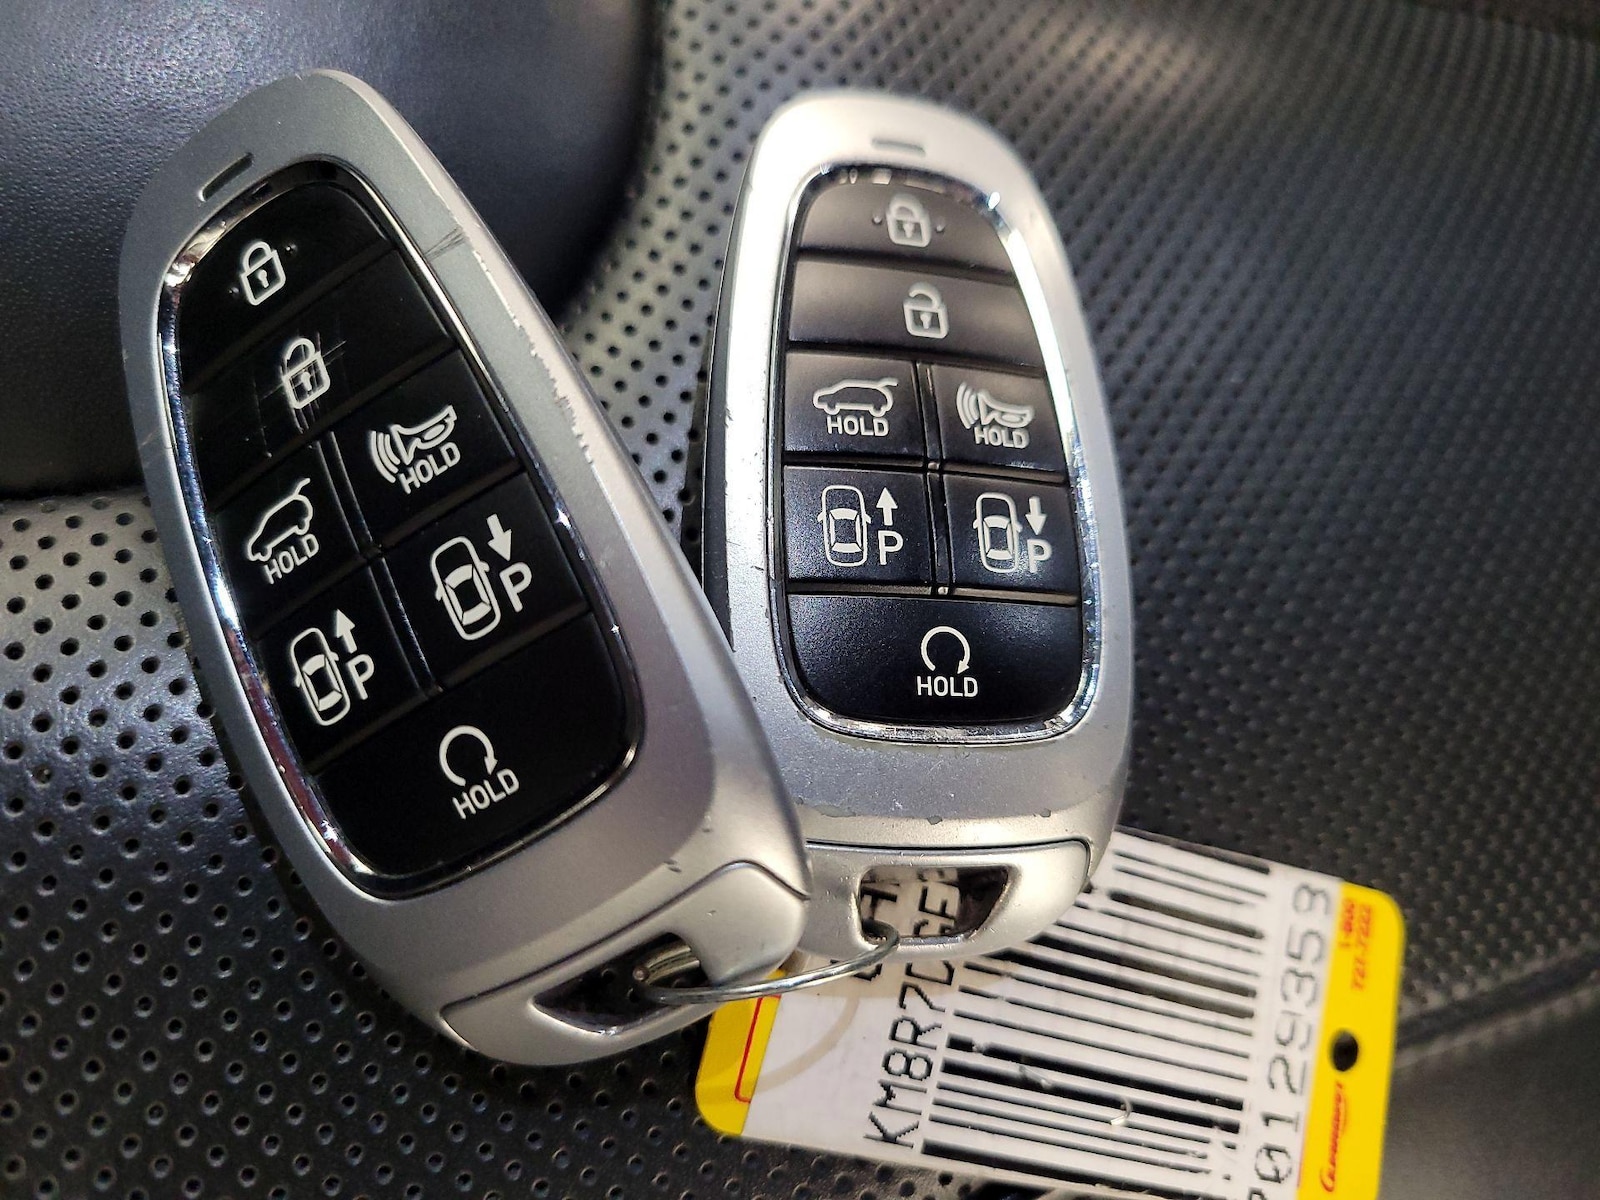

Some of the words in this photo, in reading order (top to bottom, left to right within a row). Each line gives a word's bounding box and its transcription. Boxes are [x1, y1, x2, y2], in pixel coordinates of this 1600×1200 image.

[826, 415, 889, 437] HOLD
[974, 425, 1030, 449] HOLD
[400, 442, 461, 494] HOLD
[263, 533, 320, 585] HOLD
[877, 529, 904, 566] P
[1026, 538, 1053, 574] P
[499, 562, 532, 613] P
[346, 653, 375, 700] P
[916, 675, 979, 698] HOLD
[452, 768, 520, 819] HOLD
